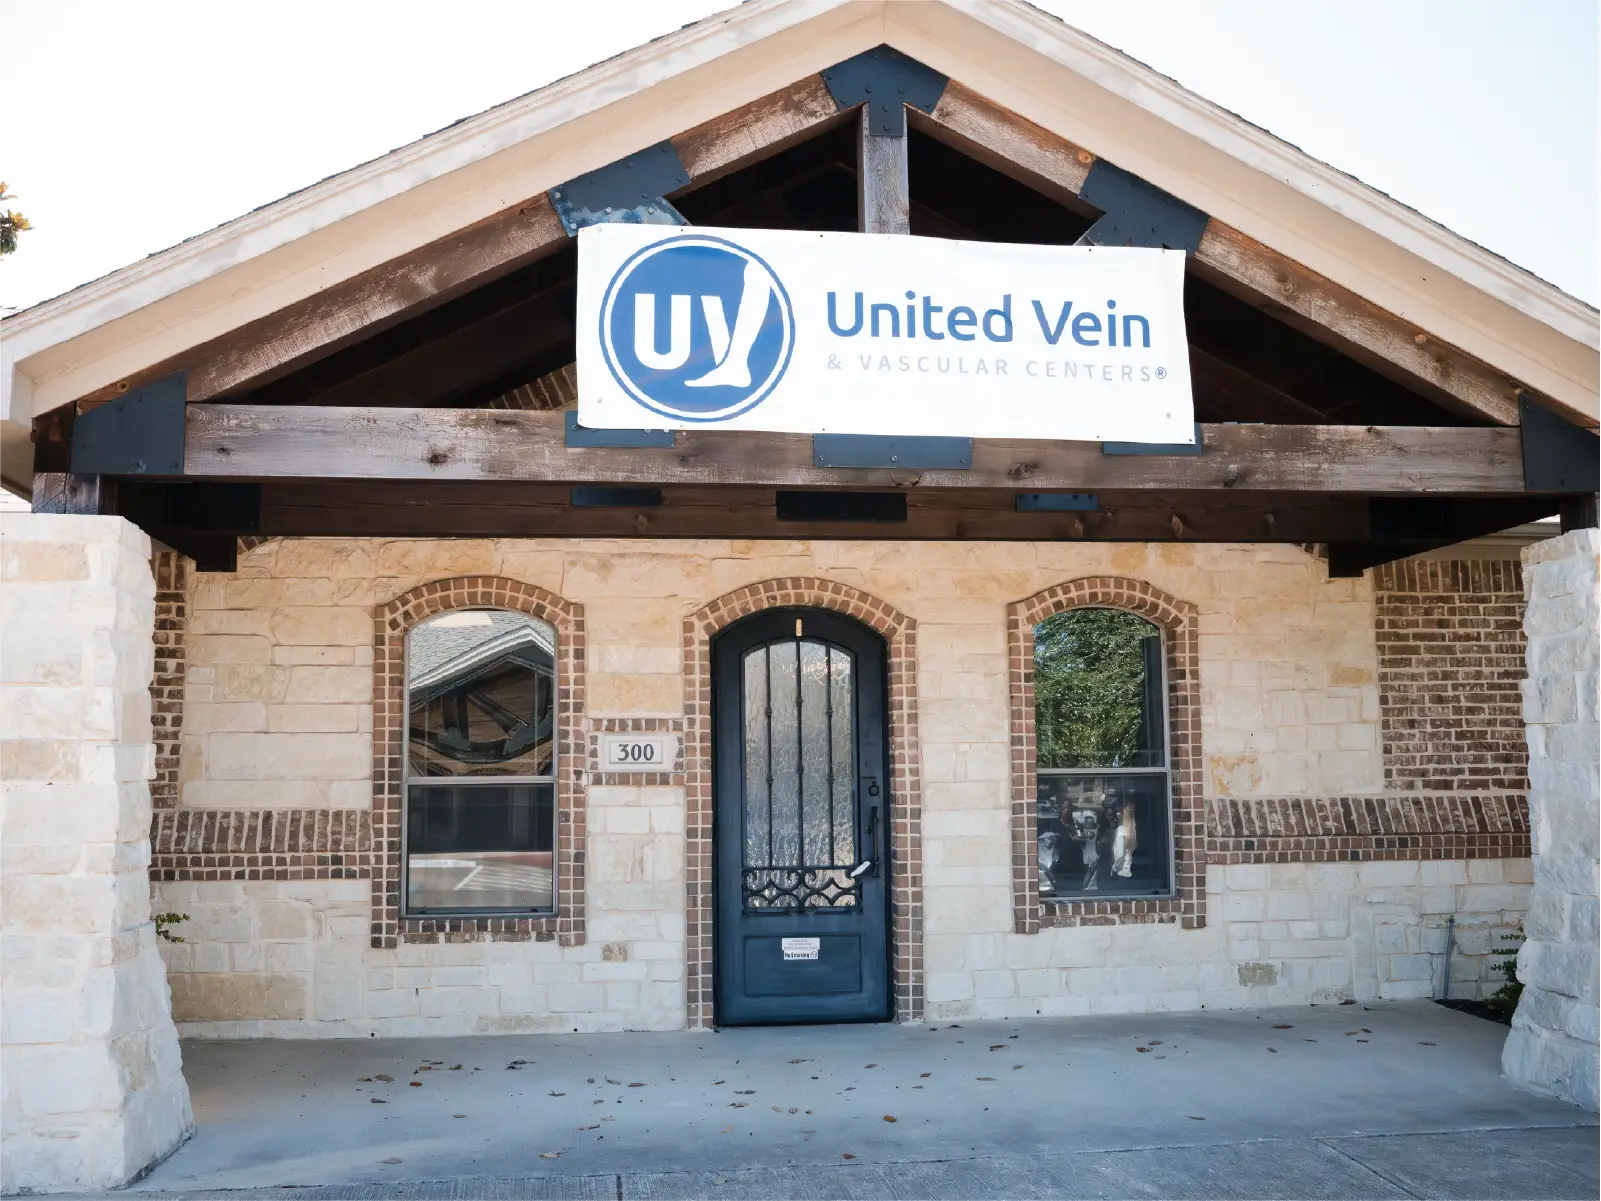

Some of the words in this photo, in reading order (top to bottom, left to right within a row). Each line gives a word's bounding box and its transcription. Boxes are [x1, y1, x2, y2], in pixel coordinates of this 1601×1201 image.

[827, 290, 1013, 342] United
[1031, 299, 1151, 347] Vein
[827, 353, 842, 370] &
[860, 355, 1009, 376] VASCULAR
[618, 743, 655, 761] 300
